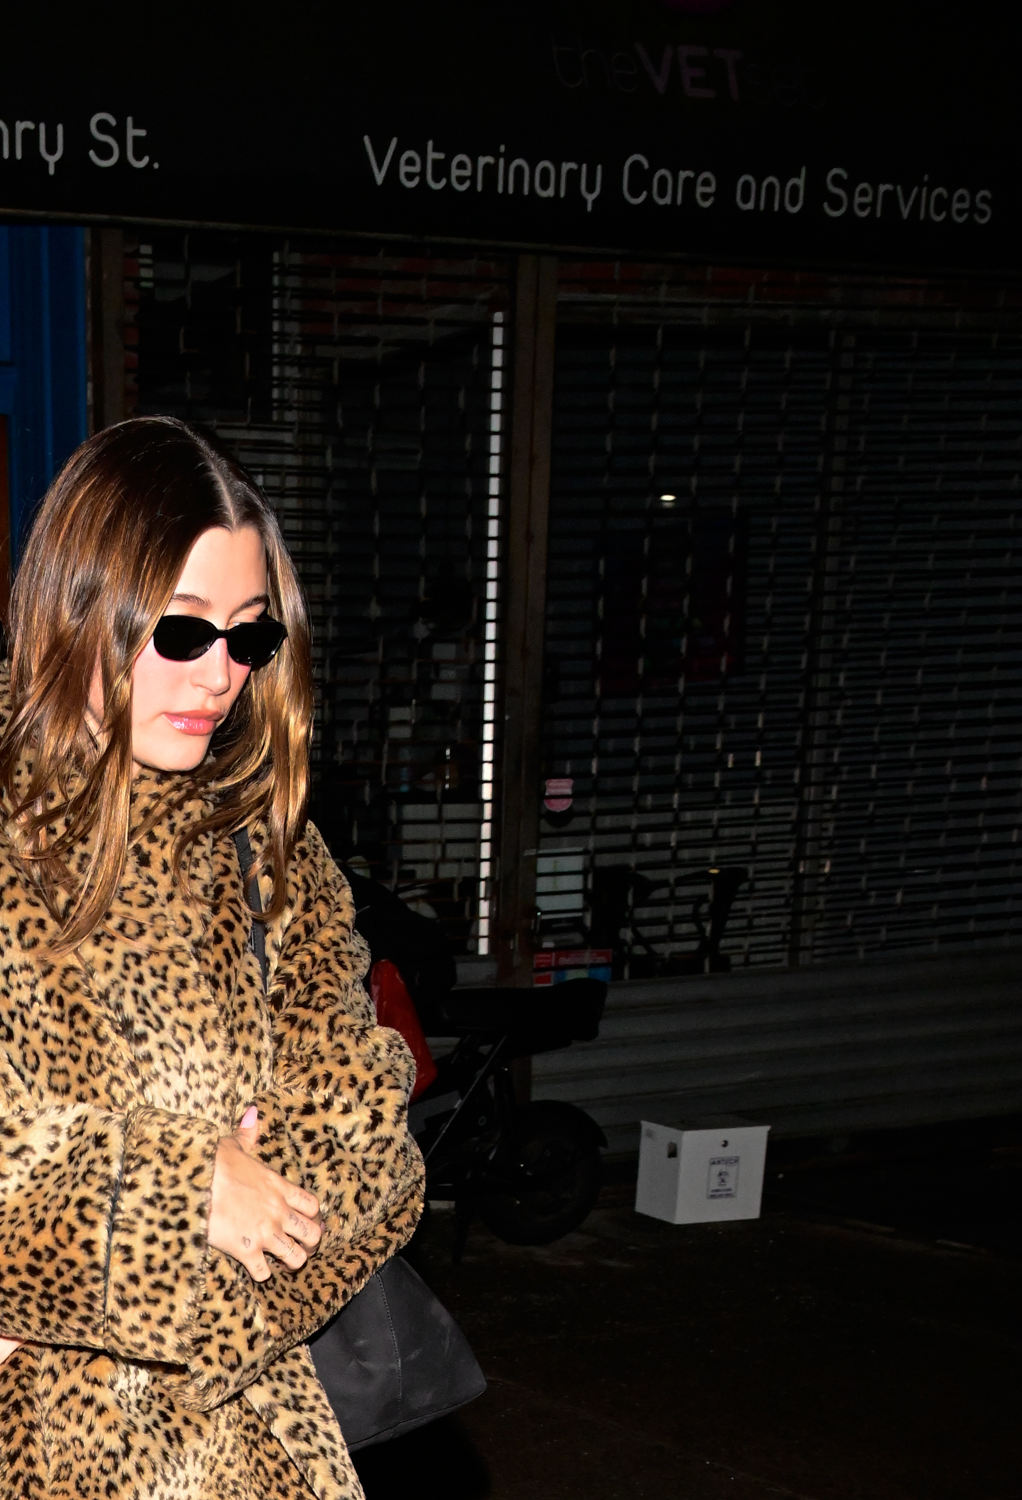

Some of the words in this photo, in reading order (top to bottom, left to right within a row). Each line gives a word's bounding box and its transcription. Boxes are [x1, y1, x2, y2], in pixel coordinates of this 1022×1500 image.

[88, 111, 160, 170] St.
[362, 134, 603, 213] Veterinary
[622, 153, 717, 208] Care
[735, 165, 807, 215] and
[823, 167, 994, 225] Services
